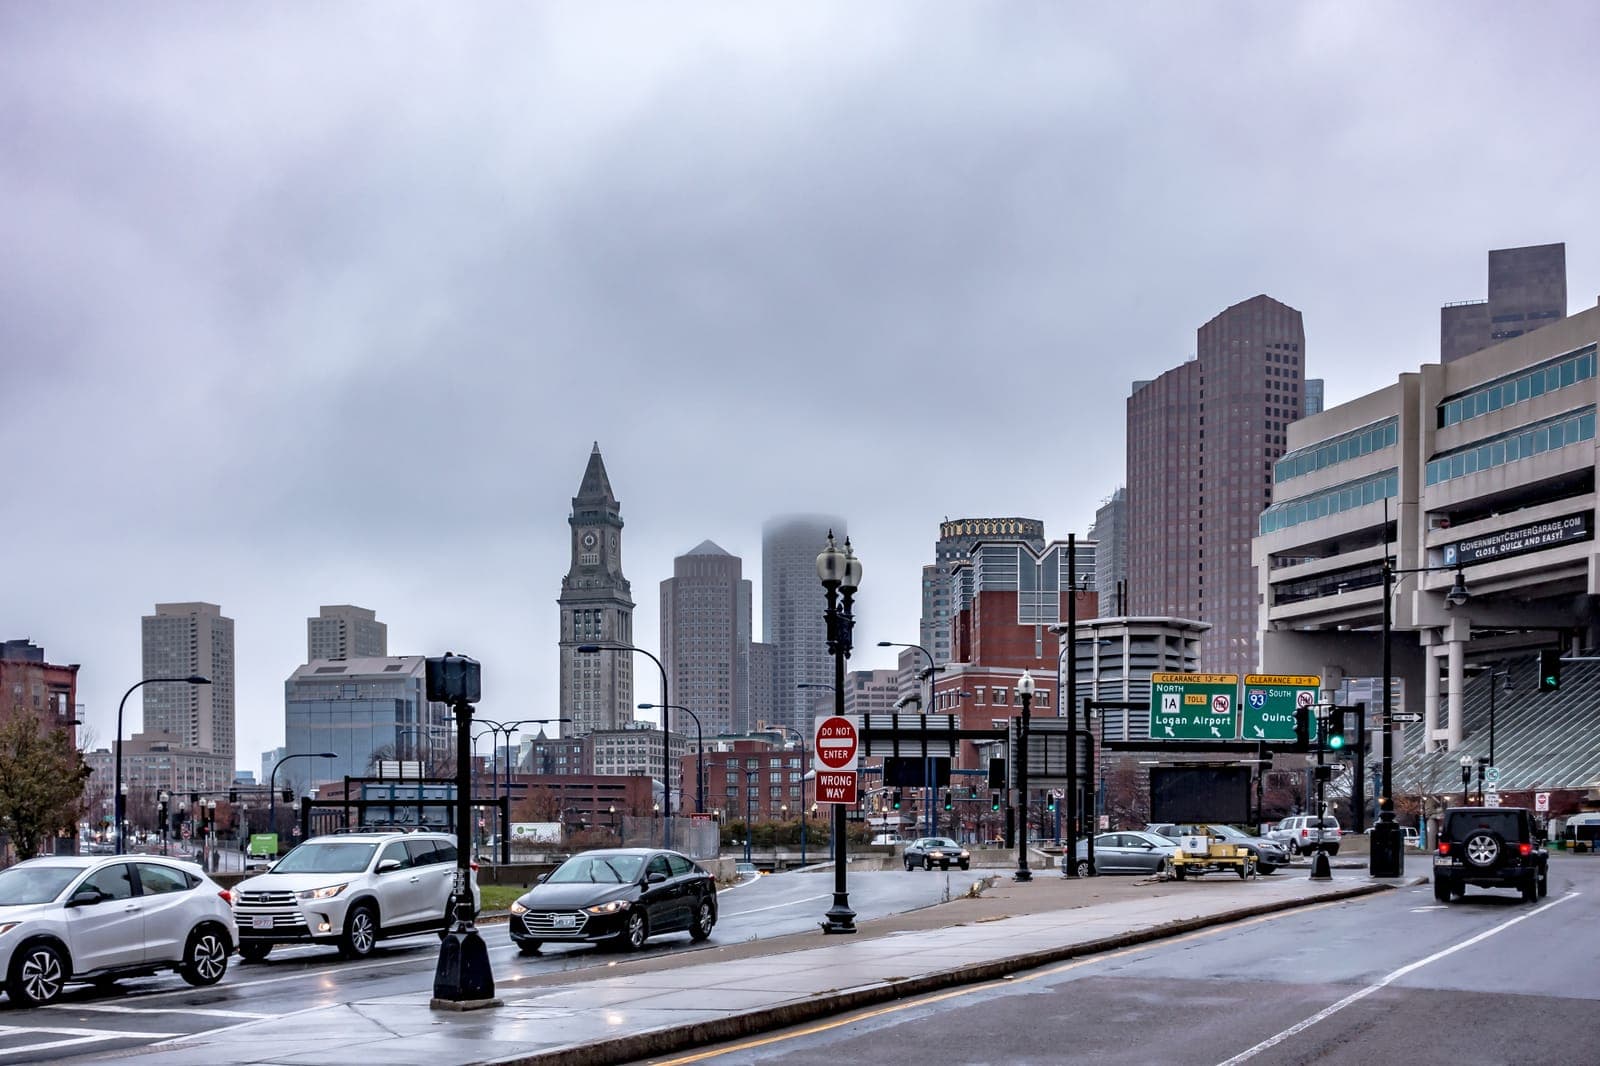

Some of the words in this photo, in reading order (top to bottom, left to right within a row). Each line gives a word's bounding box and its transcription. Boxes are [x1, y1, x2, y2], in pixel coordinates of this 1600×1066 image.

[1475, 546, 1499, 557] CLOSE,
[1500, 540, 1523, 551] QUICK
[1524, 536, 1540, 546] AND
[1542, 530, 1563, 542] EASY!
[1446, 548, 1455, 564] P
[1250, 676, 1290, 684] CLEARANCE
[1156, 684, 1184, 692] NORTH
[1269, 689, 1291, 697] SOUTH
[1164, 697, 1177, 709] 1A
[1250, 694, 1264, 705] 93
[1156, 715, 1187, 726] Logan
[1193, 716, 1231, 726] Airport
[1262, 713, 1297, 722] Quinc
[821, 727, 832, 736] DO
[836, 727, 851, 736] NOT
[823, 750, 848, 759] ENTER
[820, 775, 852, 786] WRONG
[826, 788, 845, 799] WAY
